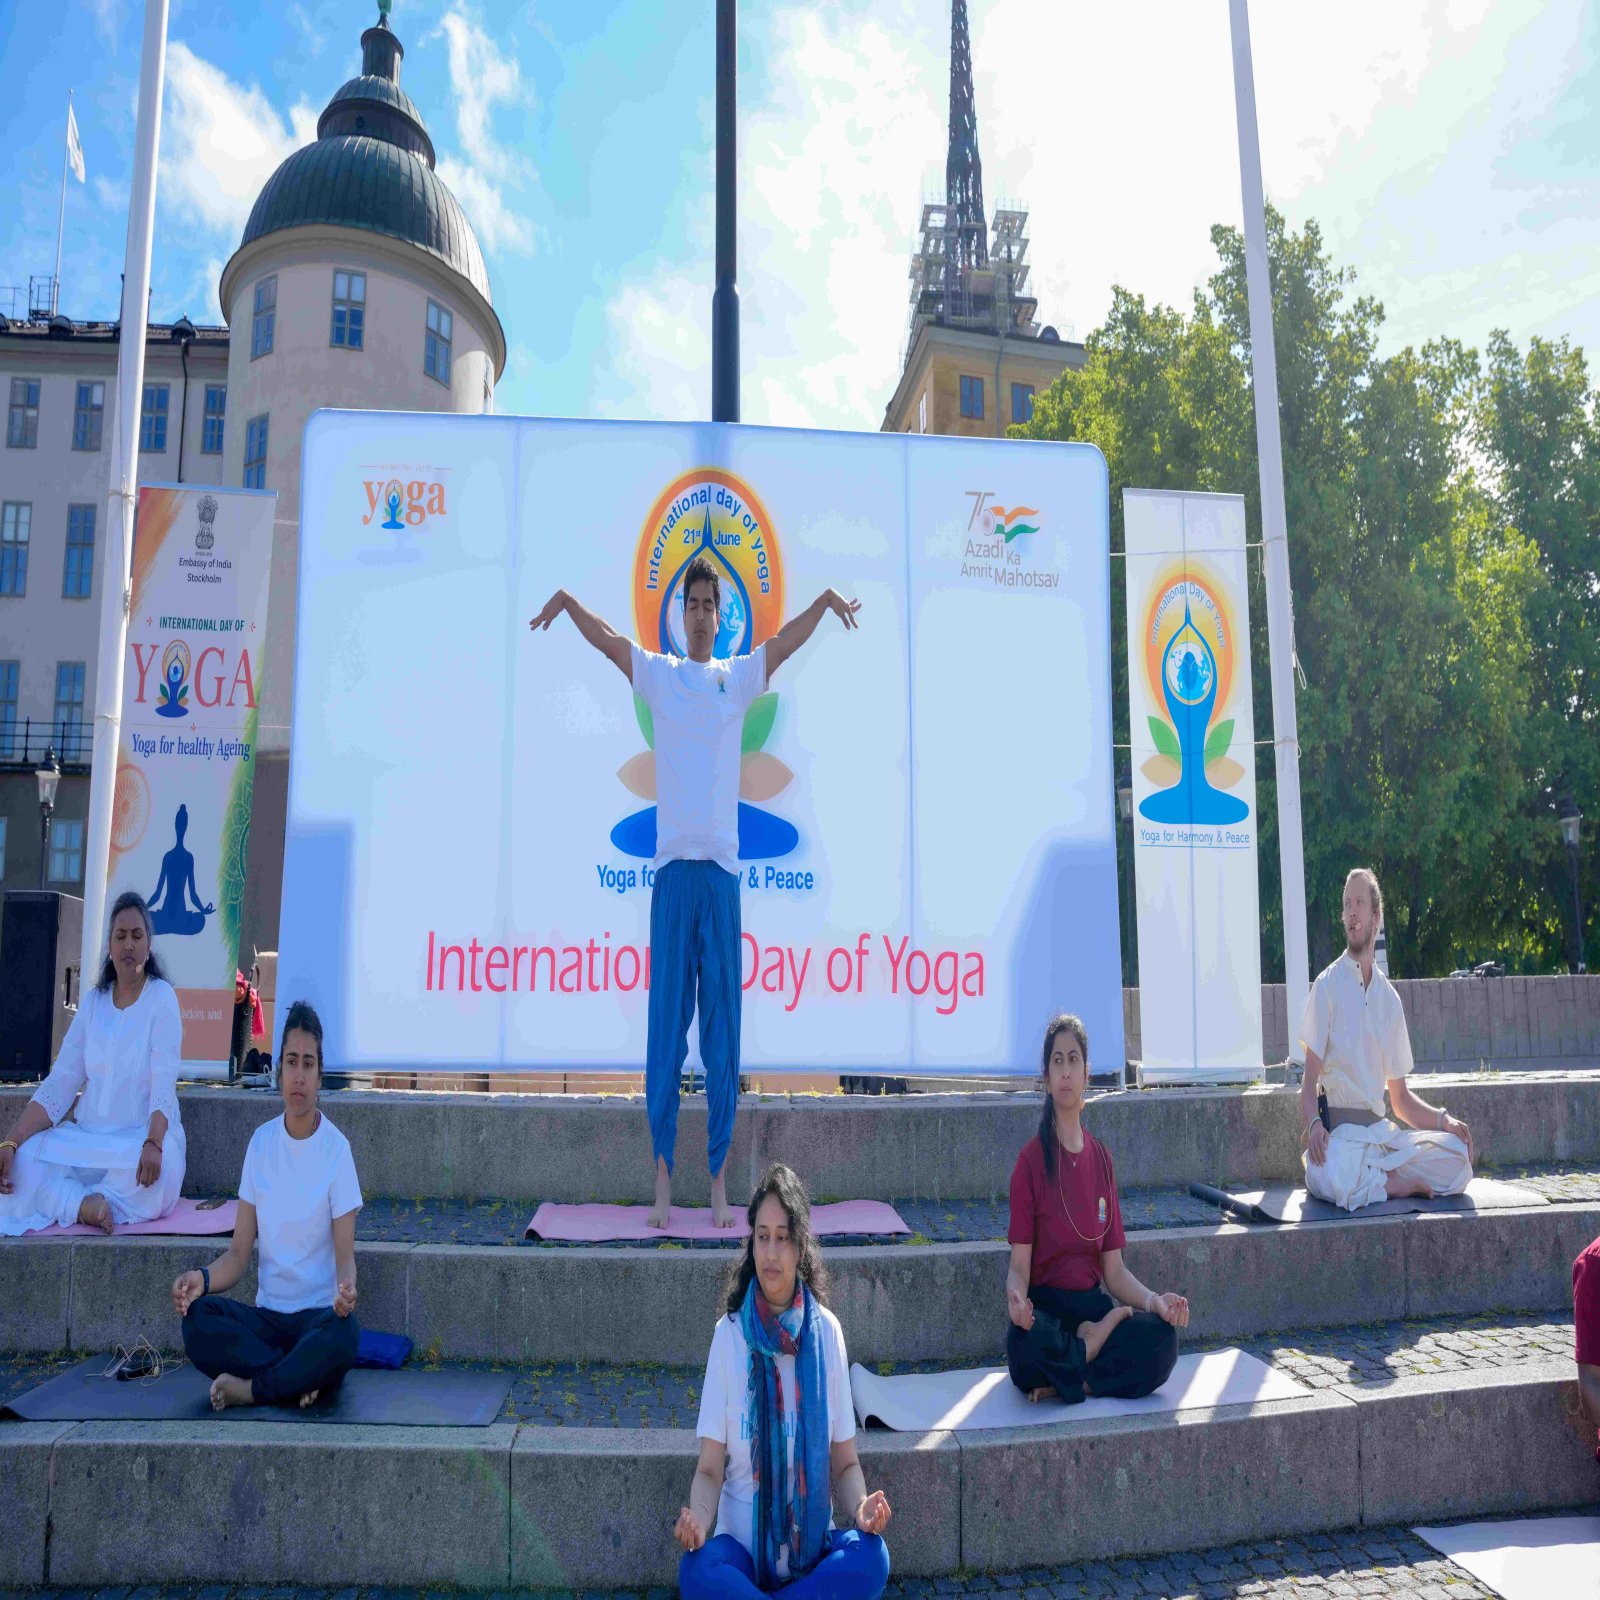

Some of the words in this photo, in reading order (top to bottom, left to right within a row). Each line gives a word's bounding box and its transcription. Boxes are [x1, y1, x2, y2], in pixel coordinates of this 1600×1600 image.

[362, 480, 447, 526] yoga
[646, 485, 711, 590] International
[716, 488, 741, 518] day
[743, 514, 758, 535] of
[751, 537, 770, 594] yoga
[683, 529, 702, 545] 21st
[714, 531, 741, 546] June
[179, 557, 207, 570] Embassy
[208, 559, 215, 568] of
[216, 560, 232, 569] India
[964, 539, 1004, 559] Azadi
[1006, 551, 1021, 566] Ka
[187, 573, 222, 583] Stockholm
[960, 563, 993, 579] Amrit
[994, 567, 1060, 588] Mahotsav
[159, 616, 217, 631] INTERNATIONAL
[219, 619, 233, 632] DAY
[234, 619, 245, 632] OF
[1152, 584, 1186, 645] International
[1189, 583, 1205, 602] Day
[1205, 599, 1216, 612] of
[131, 642, 257, 710] YOGA
[132, 733, 156, 758] Yoga
[159, 735, 175, 754] for
[177, 736, 215, 760] healthy
[216, 738, 251, 761] Ageing
[1140, 830, 1160, 844] Yoga
[1163, 830, 1175, 842] for
[1177, 831, 1214, 845] Harmony
[1216, 831, 1223, 843] &
[1225, 832, 1250, 843] Peace
[597, 865, 636, 893] Yoga
[641, 865, 655, 888] fo
[748, 865, 759, 889] &
[765, 866, 813, 890] Peace
[426, 931, 650, 992] Internatio
[827, 933, 871, 993] of
[883, 935, 985, 1015] Yoga
